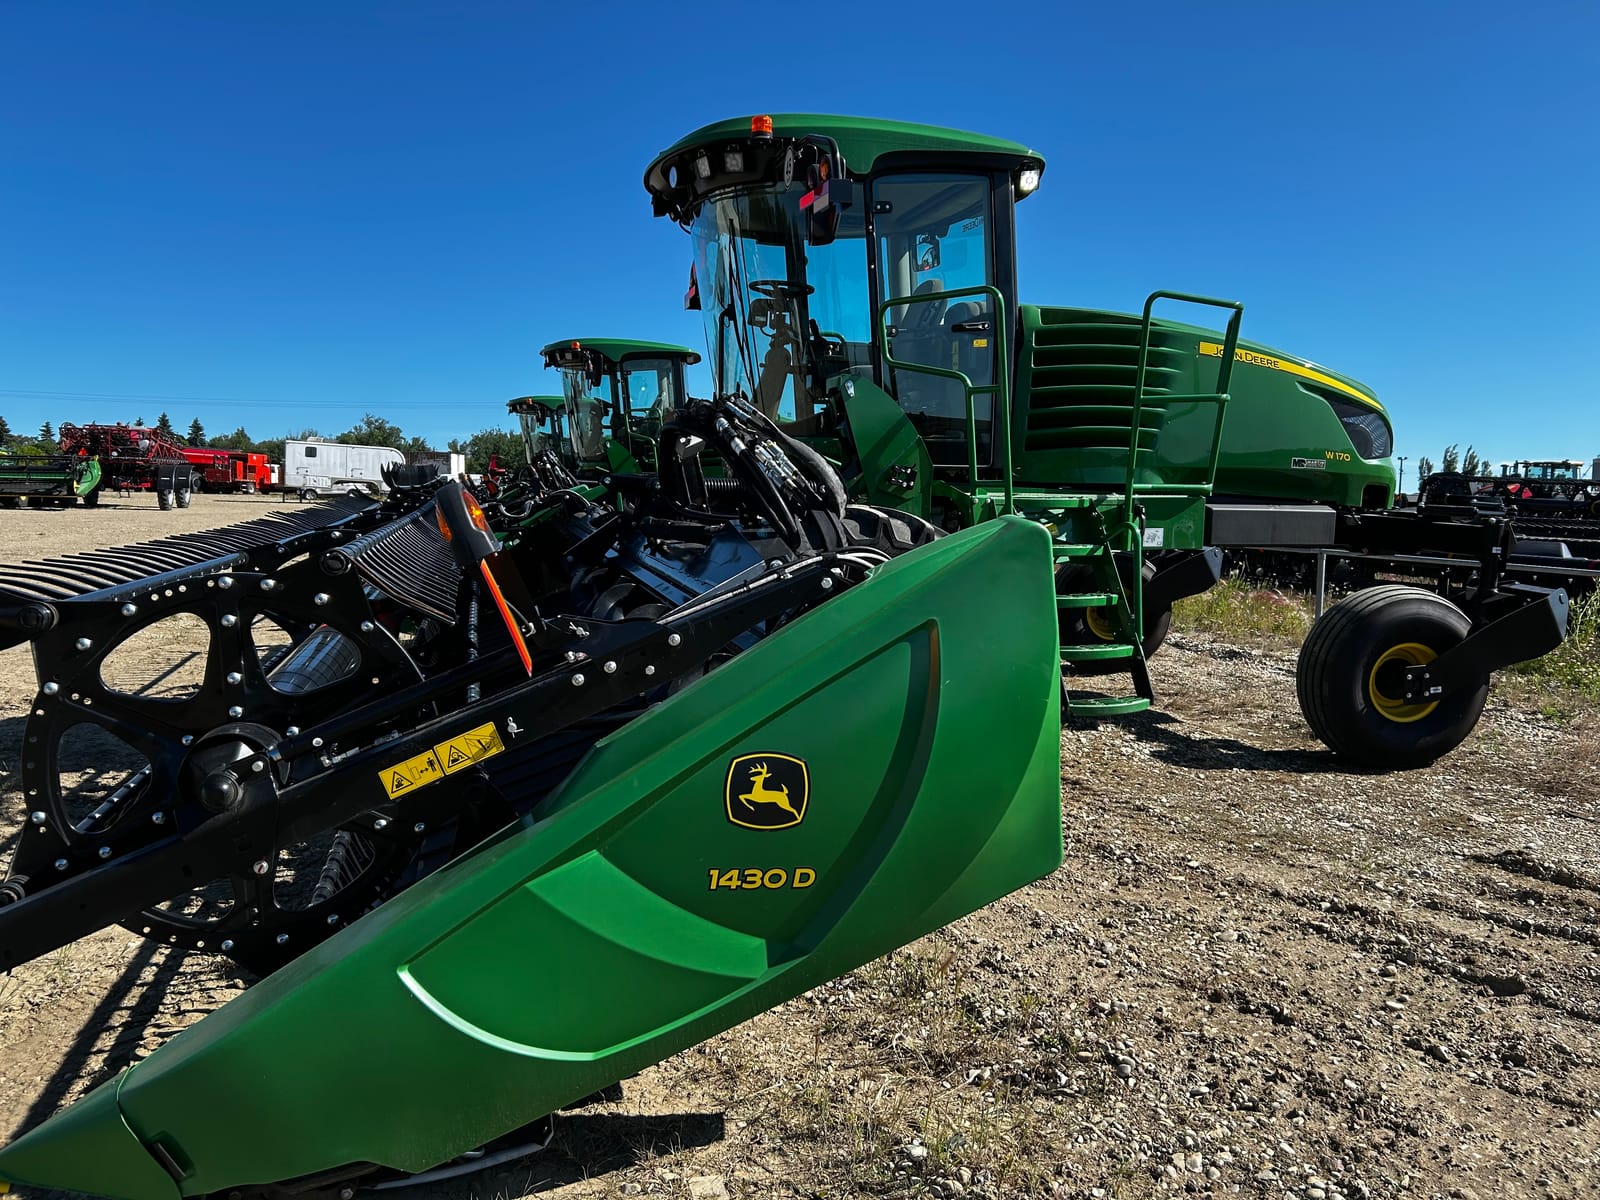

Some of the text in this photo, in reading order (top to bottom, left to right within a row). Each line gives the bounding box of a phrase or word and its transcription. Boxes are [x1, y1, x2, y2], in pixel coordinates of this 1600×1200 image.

[1213, 346, 1280, 369] JON DEERE
[1325, 450, 1351, 462] W 170
[709, 867, 817, 890] 1430 D
